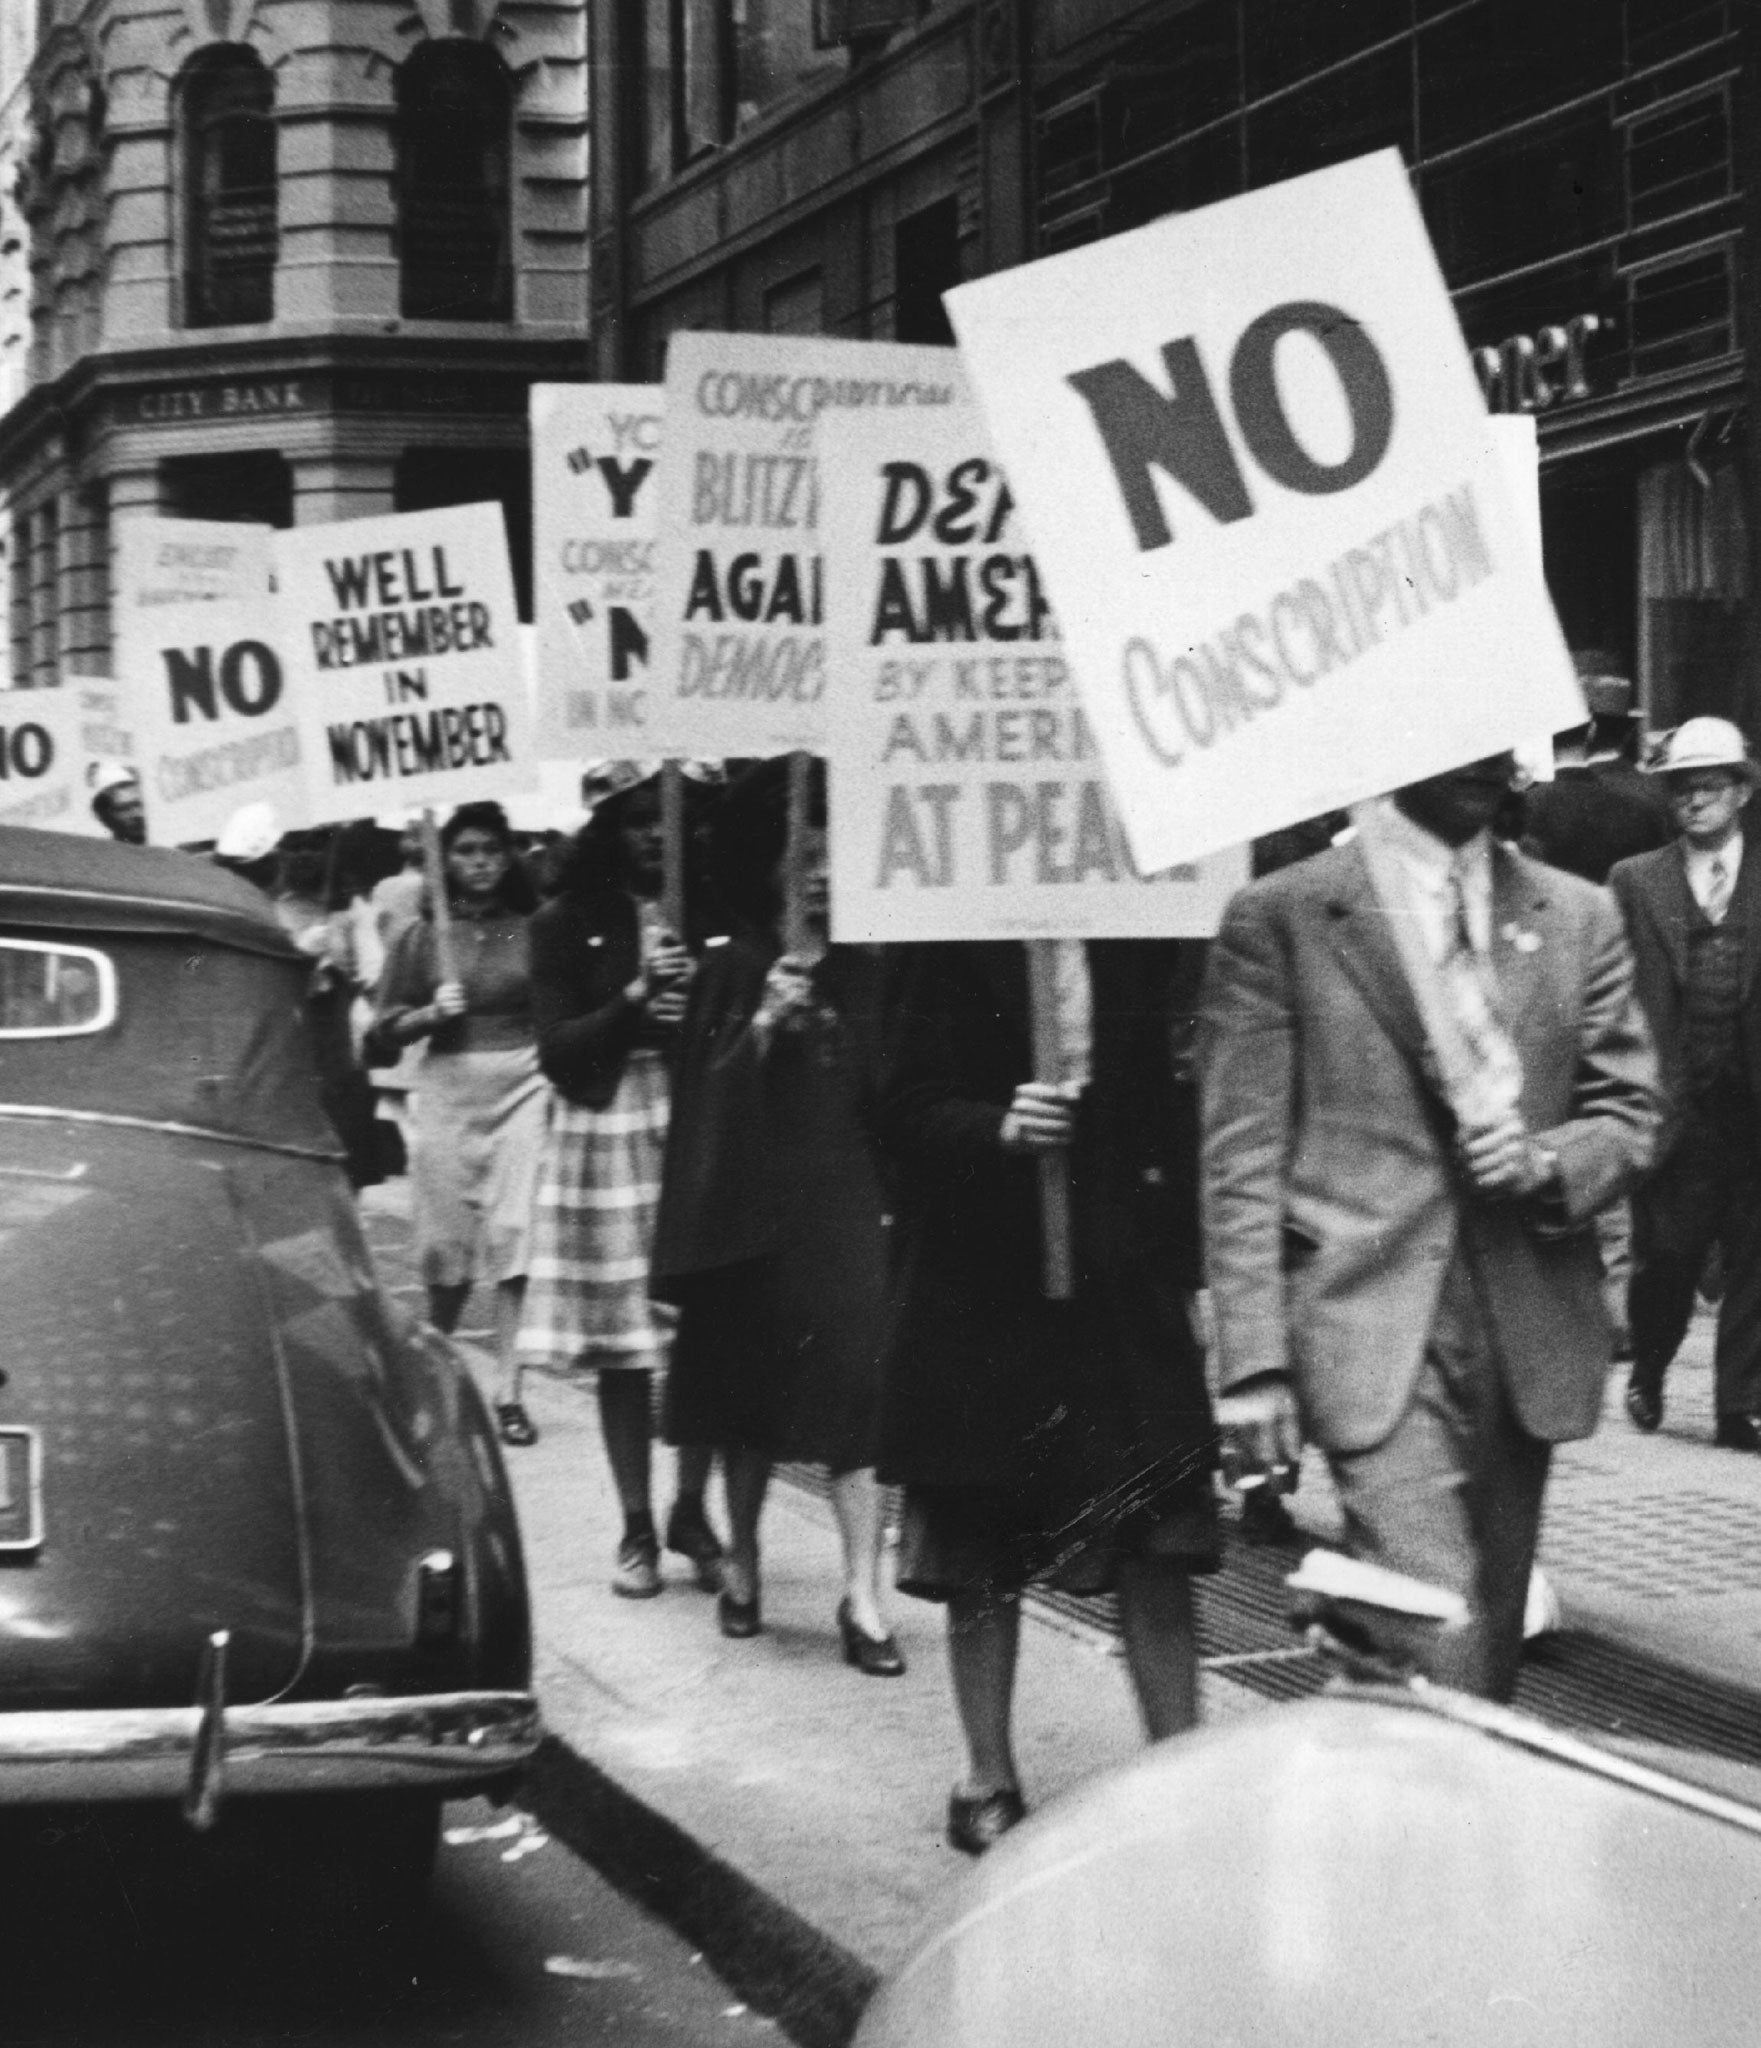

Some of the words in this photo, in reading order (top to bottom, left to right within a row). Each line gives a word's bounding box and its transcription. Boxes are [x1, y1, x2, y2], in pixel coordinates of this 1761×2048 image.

[222, 382, 304, 412] BANK
[1065, 300, 1394, 552] NO
[324, 545, 464, 611] WELL
[310, 602, 494, 672] REMEMBER
[1122, 485, 1495, 767] CONSCRIPTION
[160, 639, 283, 723] NO
[383, 668, 428, 704] IN
[874, 659, 934, 701] BY
[0, 722, 54, 780] O
[326, 702, 511, 785] NOVEMBER
[874, 783, 959, 890] AT
[984, 780, 1198, 888] PEA
